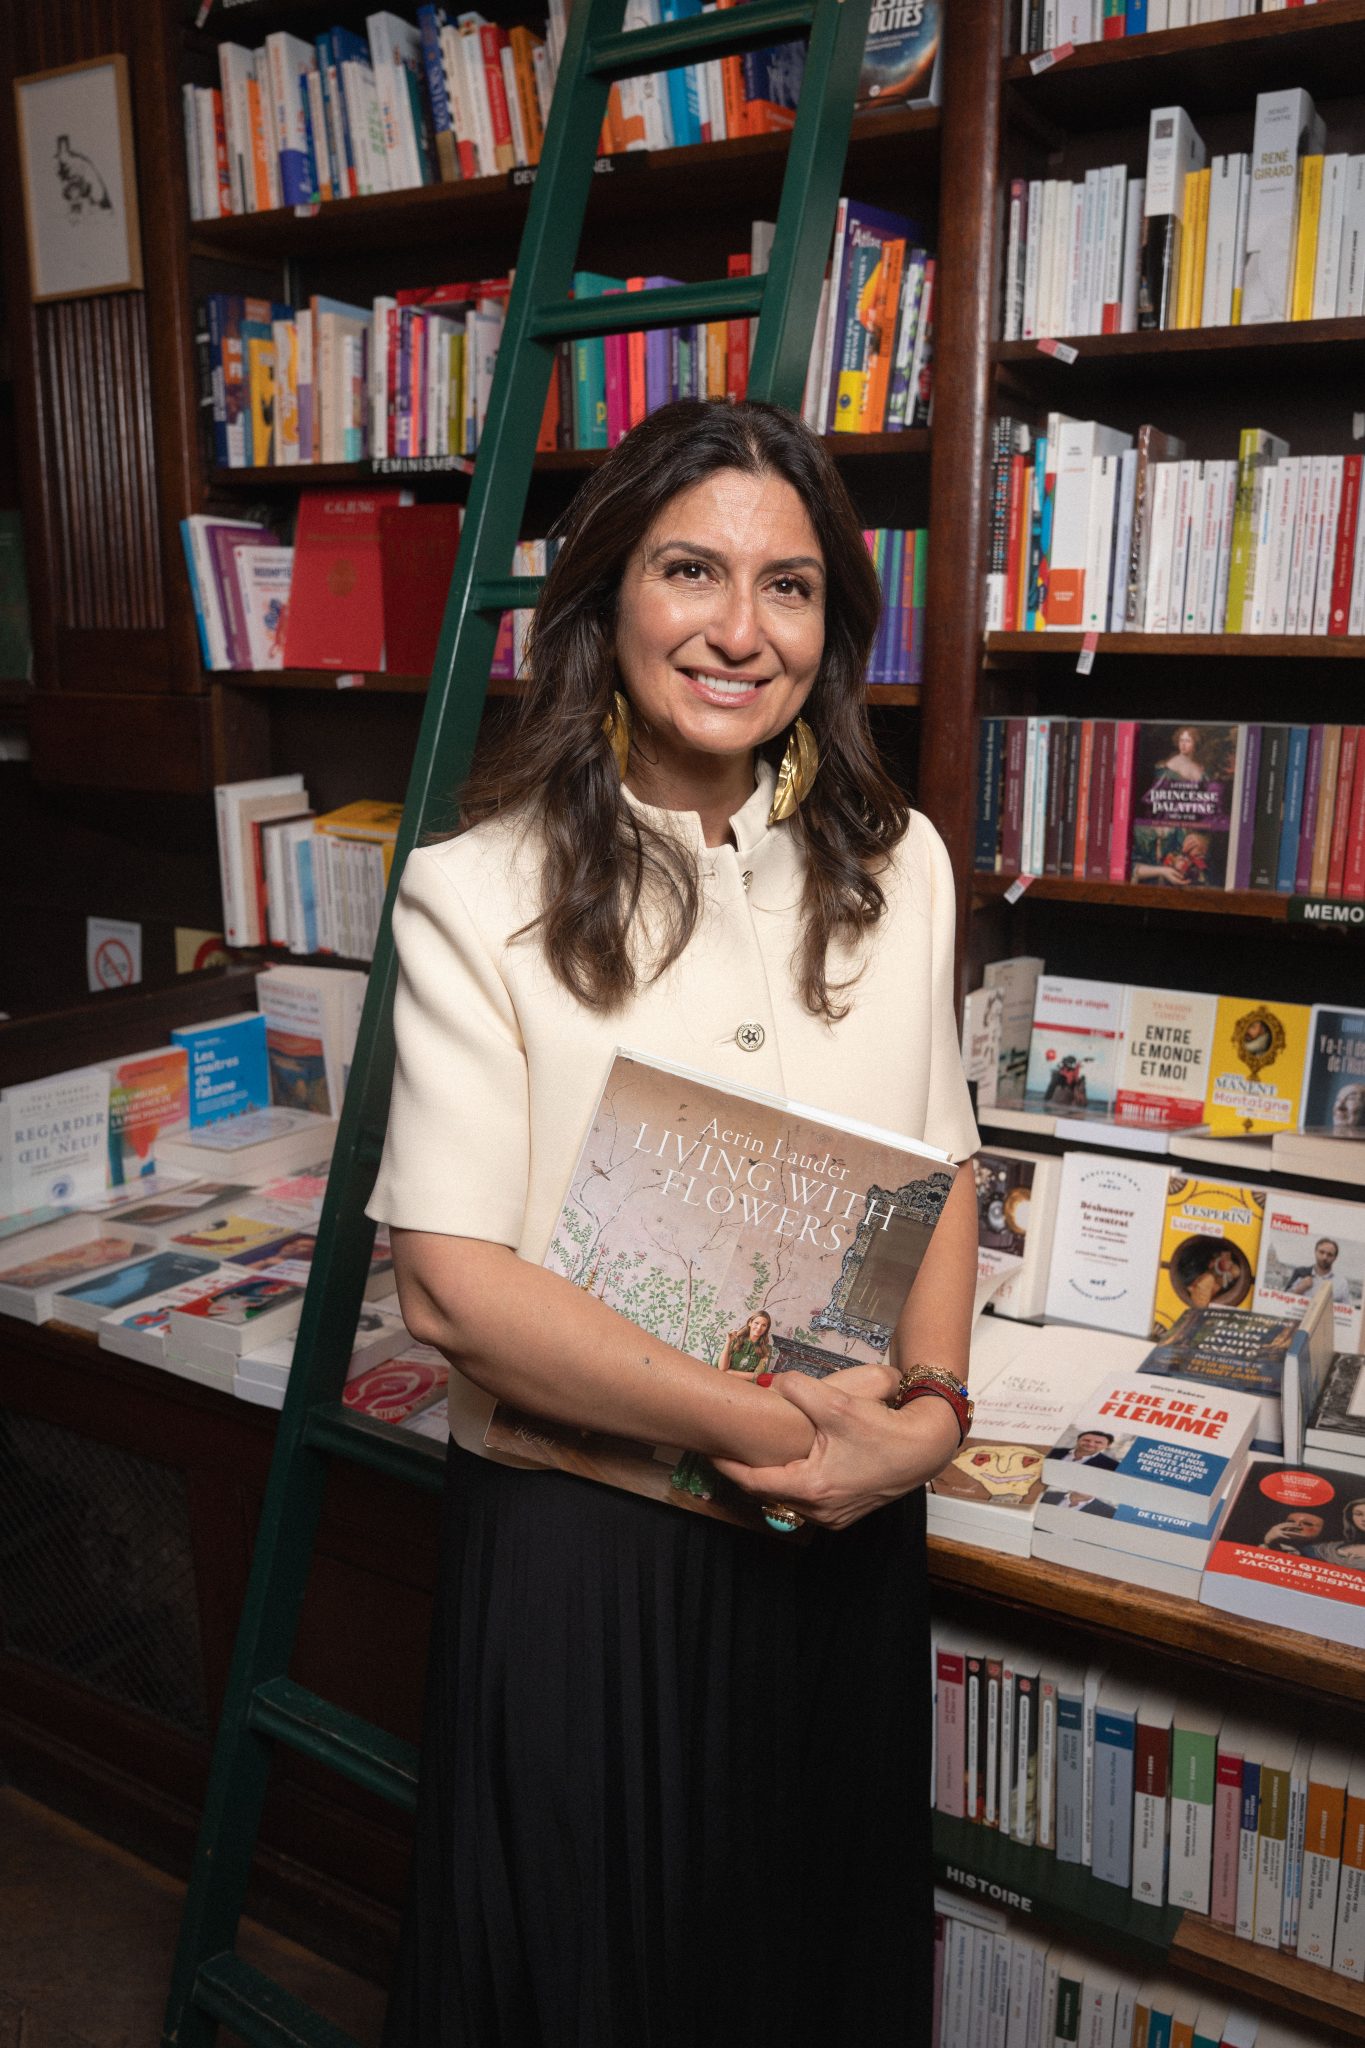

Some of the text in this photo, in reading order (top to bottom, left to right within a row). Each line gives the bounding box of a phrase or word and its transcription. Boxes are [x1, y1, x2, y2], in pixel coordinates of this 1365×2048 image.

[868, 4, 924, 34] OLITES
[1260, 149, 1289, 164] RENÉ
[1254, 164, 1294, 181] GIRARD
[1150, 789, 1218, 802] PRINCESSE
[1152, 801, 1215, 814] PALATINE
[1304, 904, 1365, 923] MEMO
[1145, 1025, 1192, 1045] ENTRE
[194, 1051, 215, 1063] Les
[1131, 1041, 1202, 1064] LE MONDE
[194, 1056, 240, 1074] maîtres
[1140, 1061, 1187, 1080] ET MOI
[195, 1076, 211, 1088] de
[195, 1080, 236, 1099] l'atome
[1215, 1078, 1276, 1096] MANENT
[1214, 1091, 1289, 1112] Montaigne
[15, 1112, 104, 1143] REGARDER
[59, 1134, 99, 1154] NEUF
[700, 1118, 850, 1181] Aerin Lauder
[632, 1122, 897, 1232] LIVING WITH
[661, 1168, 846, 1251] FLOWERS
[1080, 1201, 1134, 1217] Déshonorer
[1183, 1205, 1251, 1224] VESPERINI
[1094, 1216, 1129, 1228] contrat
[1172, 1219, 1223, 1235] Lucrèce
[1271, 1218, 1308, 1235] Mounk
[1258, 1289, 1269, 1298] Le
[1270, 1291, 1296, 1305] Piège
[1298, 1297, 1309, 1306] de
[1204, 1336, 1261, 1349] avons
[1214, 1329, 1261, 1341] nous
[1099, 1402, 1224, 1440] FLEMME
[1168, 1400, 1198, 1415] DE
[1201, 1407, 1229, 1423] LA
[1148, 1448, 1206, 1467] NOUS ET NOS
[1157, 1444, 1202, 1459] COMMENT
[1137, 1458, 1203, 1479] PERDU LE SENS
[1138, 1452, 1208, 1475] ENFANTS AVONS
[1140, 1465, 1193, 1483] DE L'EFFORT
[1137, 1510, 1192, 1528] DE L'EFFORT
[1235, 1548, 1365, 1584] PASCAL QUIGNA
[1239, 1557, 1313, 1579] JACQUES
[1310, 1856, 1318, 1878] l'empire
[1317, 1858, 1326, 1887] Habsbourg
[947, 1865, 1032, 1912] HISTOIRE
[1353, 1872, 1362, 1901] Habsbourg
[1343, 1870, 1354, 1923] Histoire de l'empire
